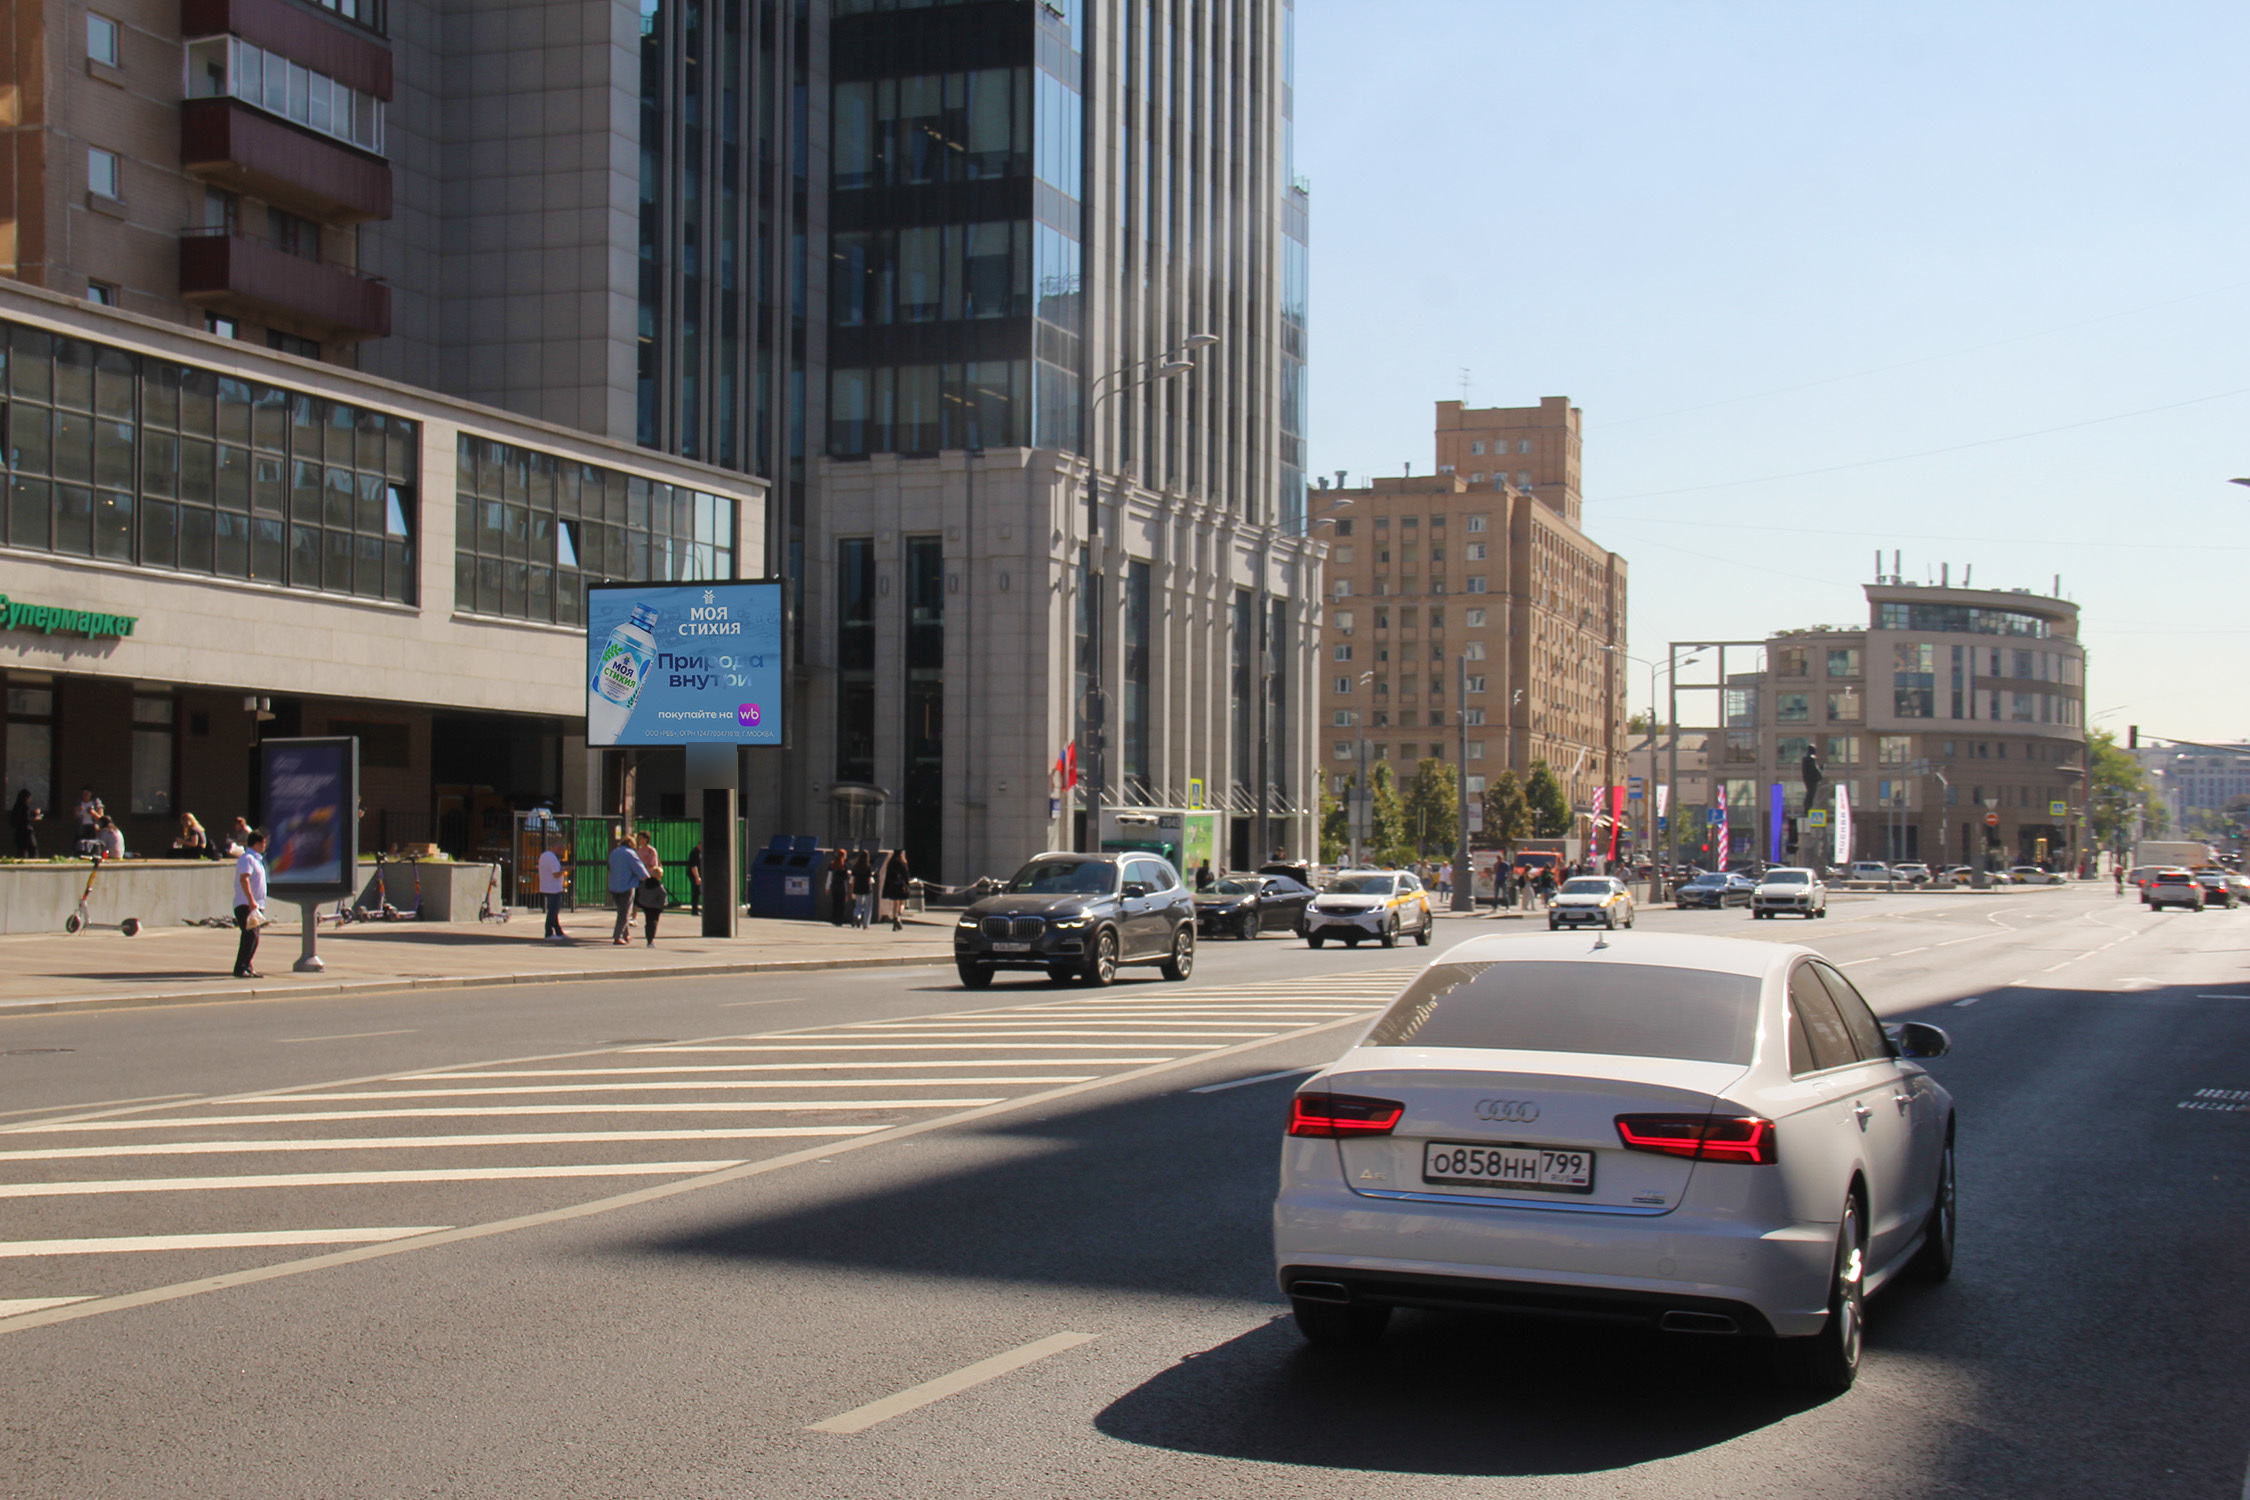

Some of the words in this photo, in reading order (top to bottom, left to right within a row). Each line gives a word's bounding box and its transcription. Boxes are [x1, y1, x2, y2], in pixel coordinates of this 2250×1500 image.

[690, 606, 728, 621] МОЯ
[678, 622, 741, 636] СТИХИЯ
[612, 661, 634, 677] МОЯ
[603, 667, 637, 688] СТИХИЯ
[669, 673, 753, 690] внутри
[658, 709, 717, 721] покупайте
[719, 711, 733, 719] на
[739, 708, 759, 720] wb
[1542, 1152, 1583, 1174] 799
[1550, 1174, 1572, 1183] RUS
